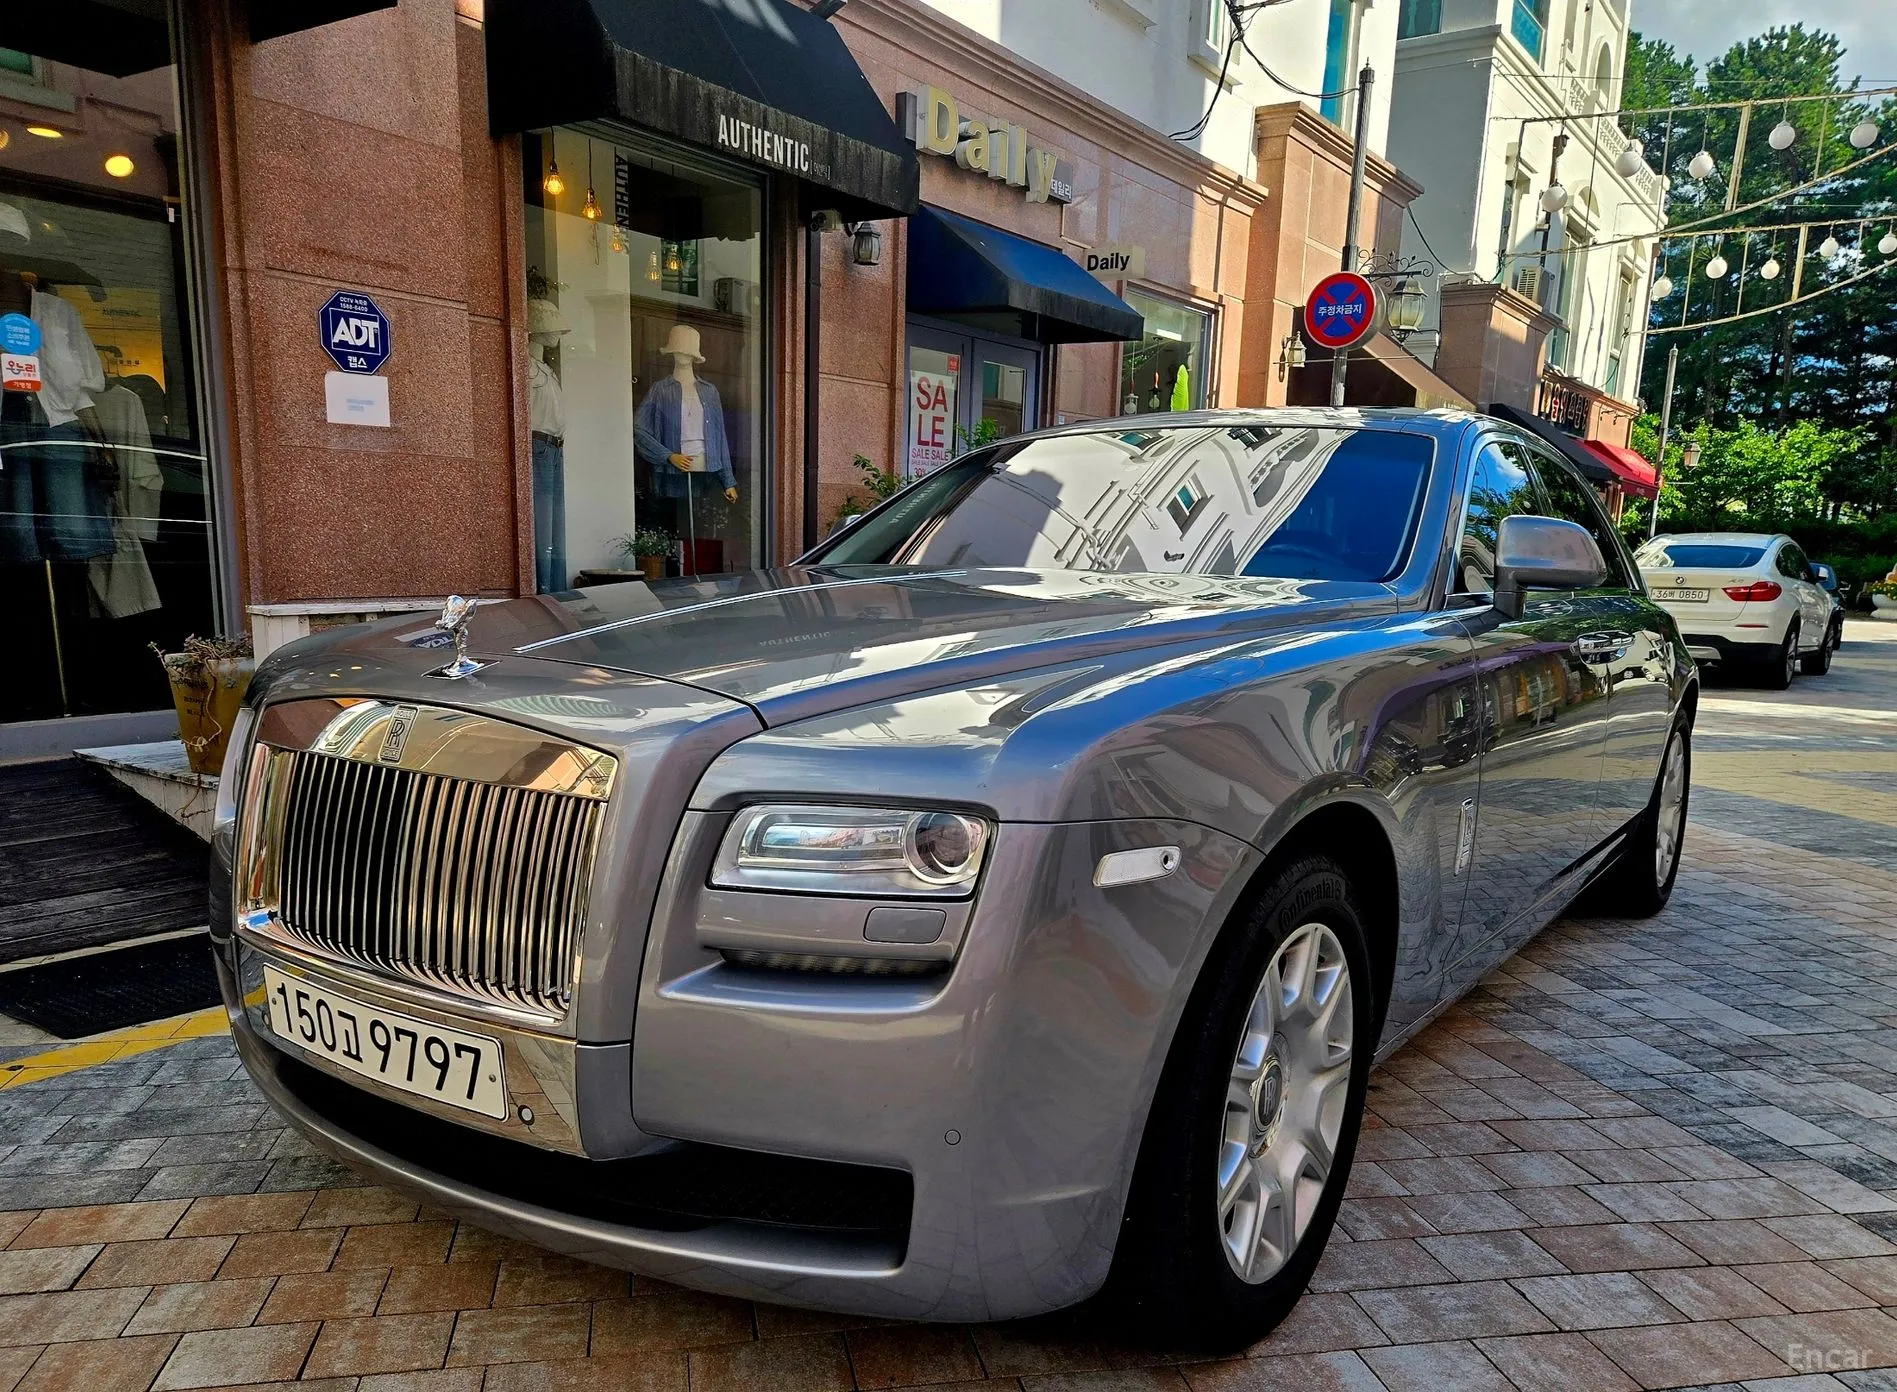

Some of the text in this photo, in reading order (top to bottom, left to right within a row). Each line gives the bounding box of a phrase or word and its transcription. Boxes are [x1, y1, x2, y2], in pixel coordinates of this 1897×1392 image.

[718, 113, 809, 172] AUTHENTIC
[916, 84, 1057, 204] Daily
[1050, 178, 1073, 200] 데일리
[1086, 252, 1130, 272] Daily
[339, 296, 354, 304] CCTV
[1318, 303, 1362, 317] 주정차금지
[332, 316, 379, 348] ADT
[347, 355, 368, 369] 캡스
[916, 376, 948, 412] SA
[917, 413, 945, 448] LE
[911, 448, 949, 461] SALE SALE
[1679, 590, 1703, 599] 0850
